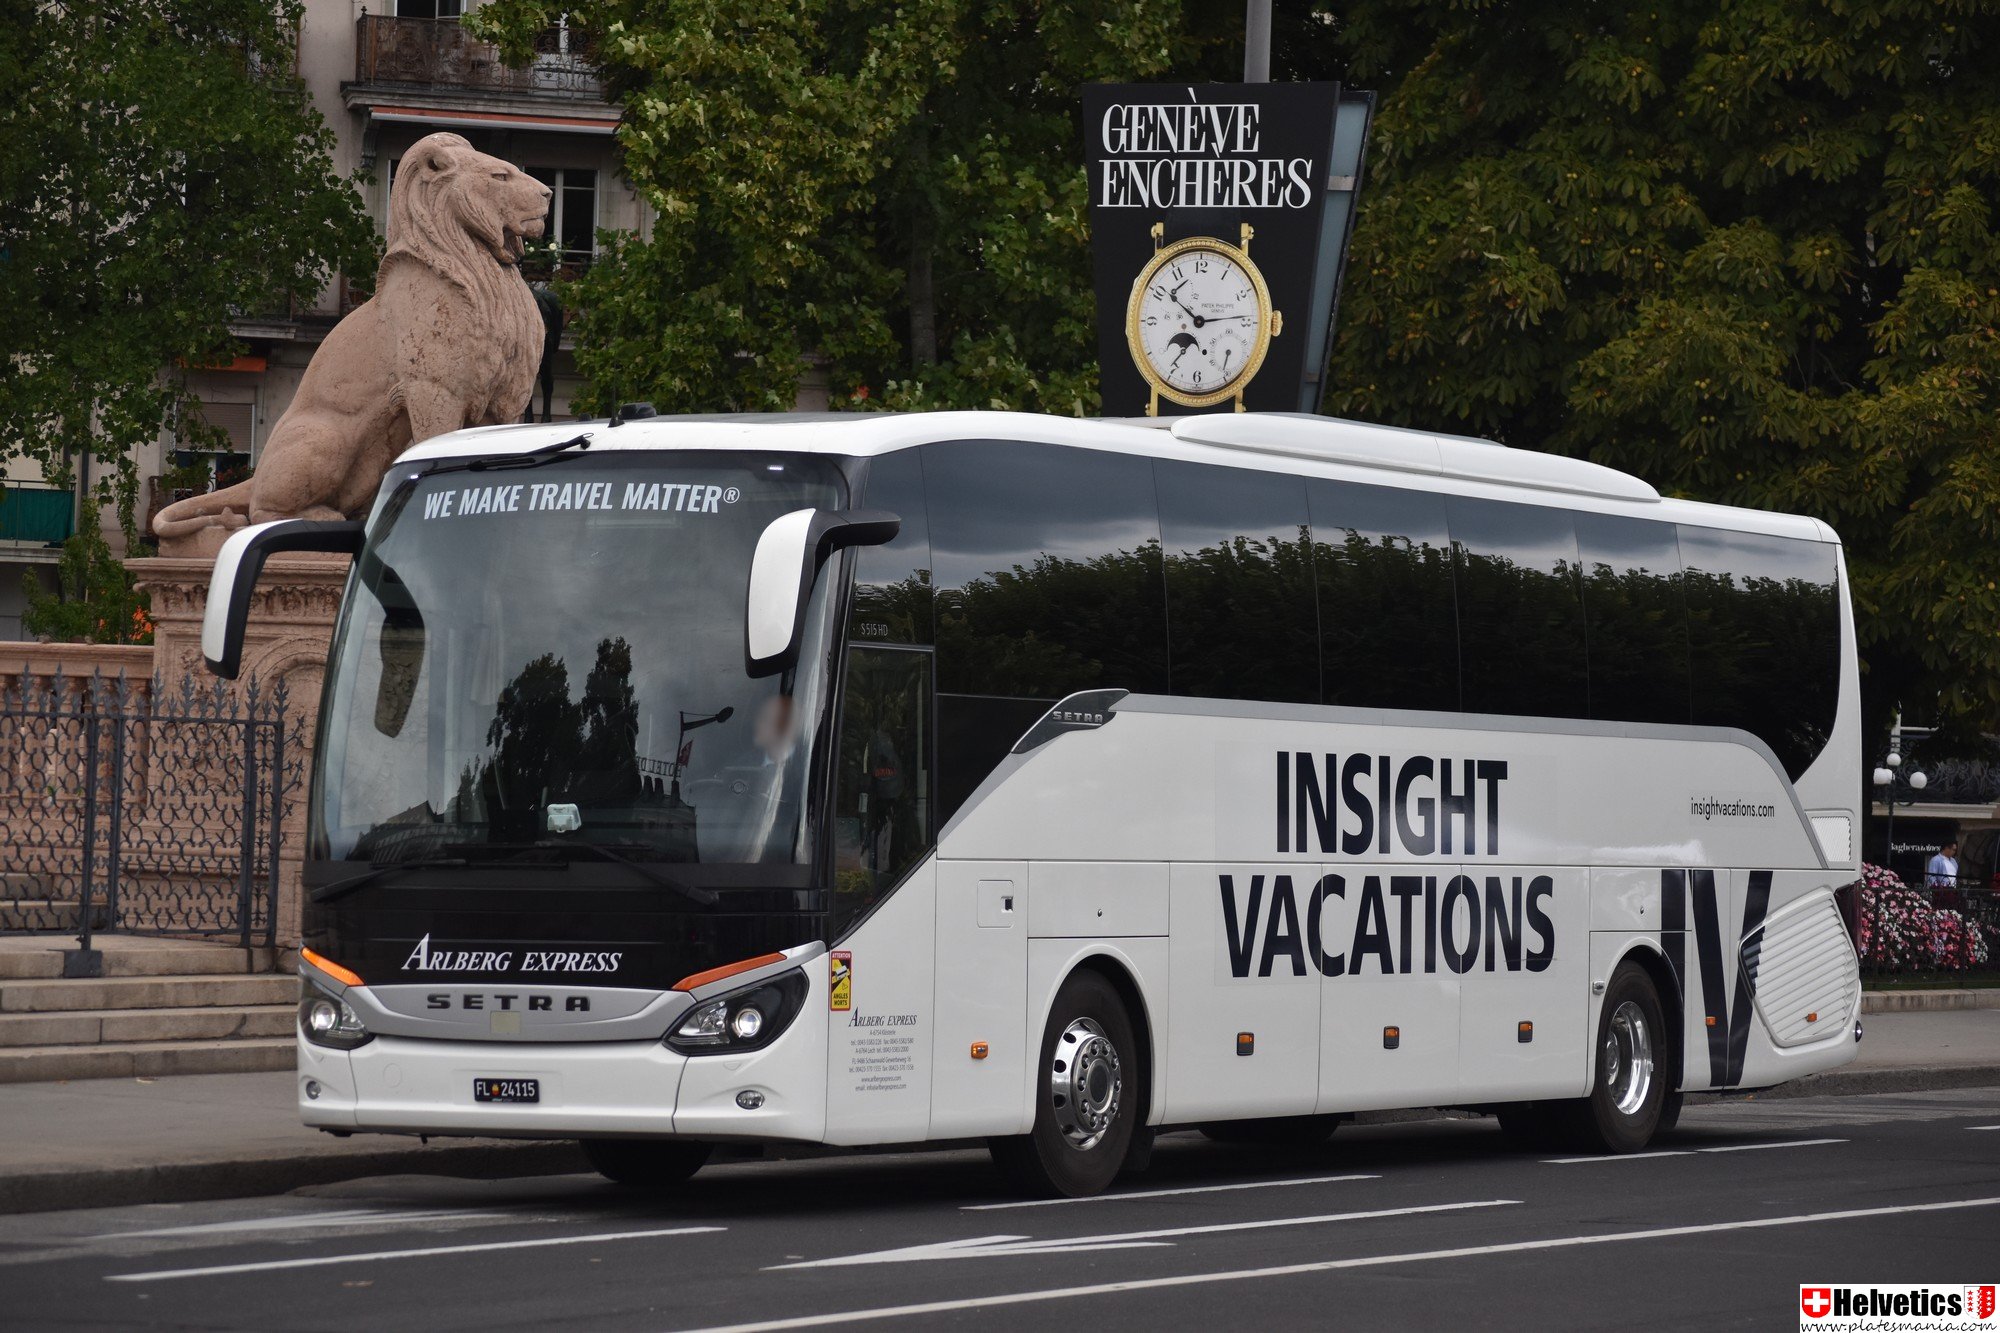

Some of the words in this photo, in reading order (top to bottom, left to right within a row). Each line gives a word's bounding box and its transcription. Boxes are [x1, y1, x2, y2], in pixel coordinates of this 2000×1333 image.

[1102, 87, 1260, 154] GENÈVE
[1097, 142, 1313, 209] ENCHÈRES
[1195, 260, 1208, 274] 12
[1192, 370, 1202, 383] 6
[424, 490, 454, 520] WE
[457, 485, 523, 516] MAKE
[528, 482, 613, 511] TRAVEL
[1052, 710, 1103, 724] SETRA
[1276, 750, 1508, 856] INSIGHT
[1691, 796, 1775, 820] insightvacations.com
[1218, 873, 1556, 978] VACATIONS
[401, 932, 513, 972] ARLBERG
[520, 952, 623, 972] EXPRESS
[427, 993, 591, 1011] SETRA
[848, 1006, 885, 1027] ARLBERG
[887, 1014, 918, 1026] EXPRESS
[476, 1081, 490, 1096] FL
[501, 1082, 536, 1097] 24115
